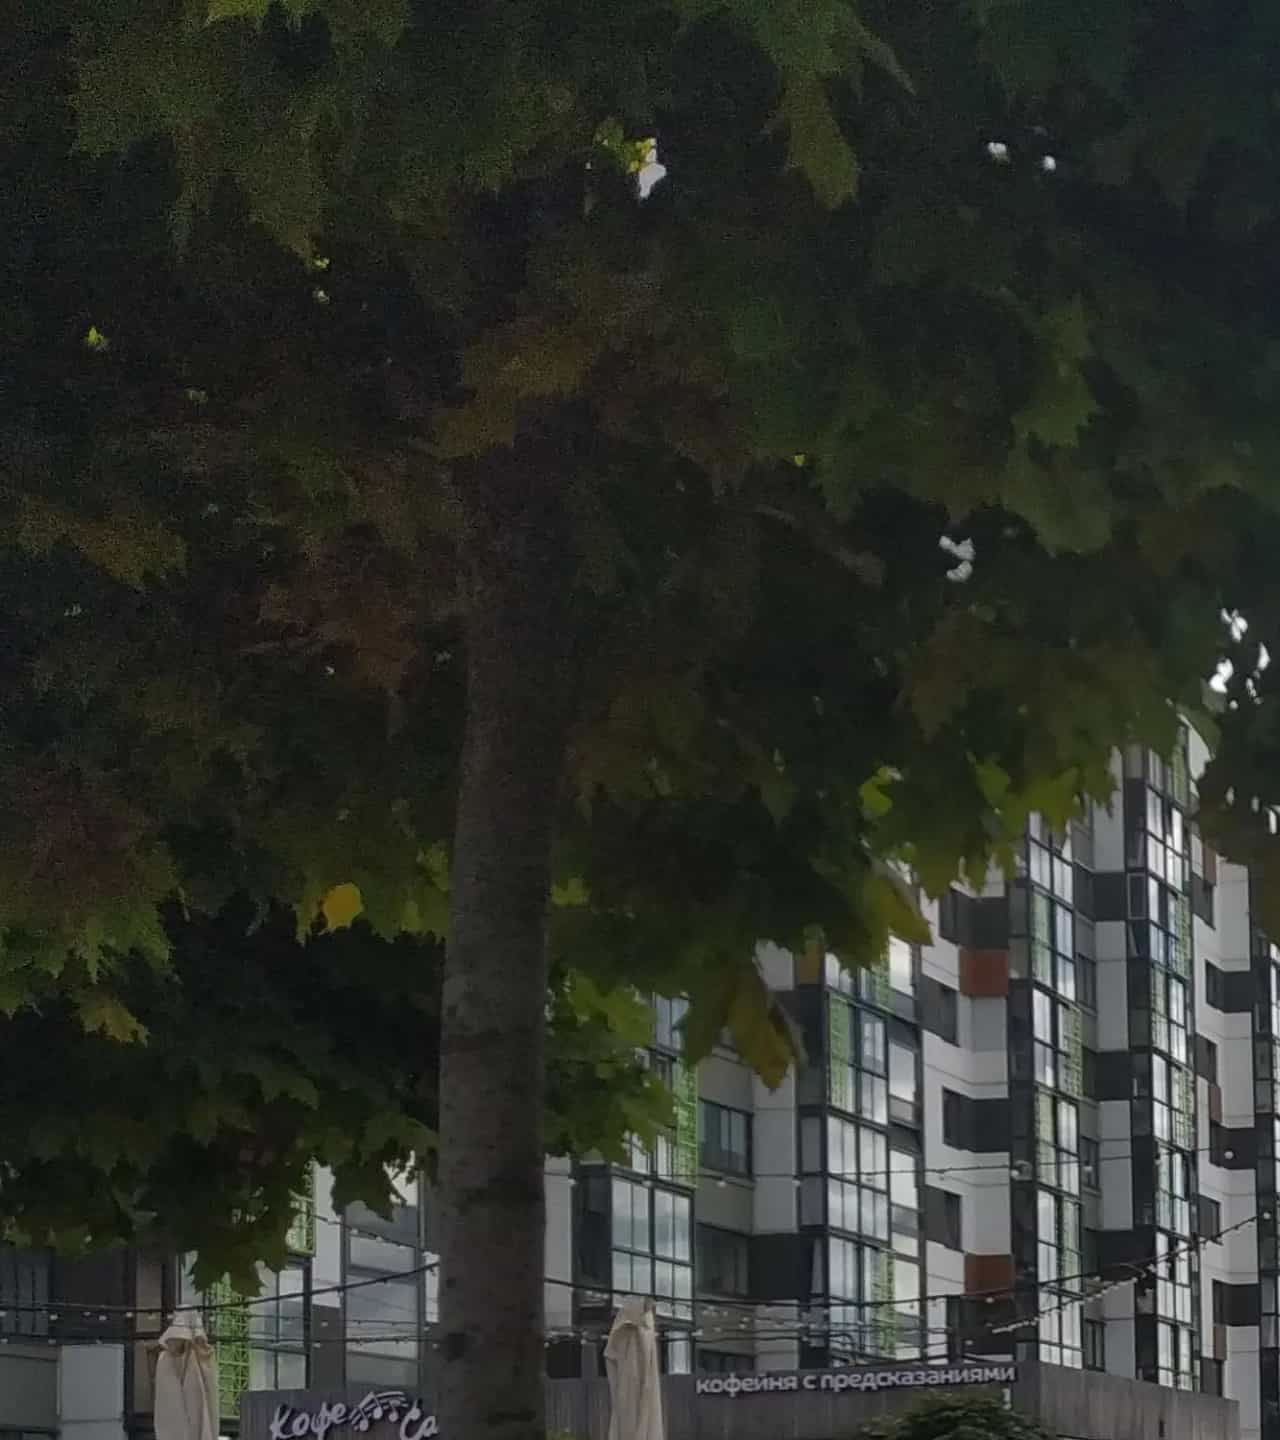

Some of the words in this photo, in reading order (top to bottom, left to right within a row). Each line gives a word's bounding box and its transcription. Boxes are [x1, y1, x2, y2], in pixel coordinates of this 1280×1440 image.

[696, 1372, 798, 1397] кофейня
[803, 1374, 816, 1389] с
[820, 1367, 1016, 1392] предсказаниями
